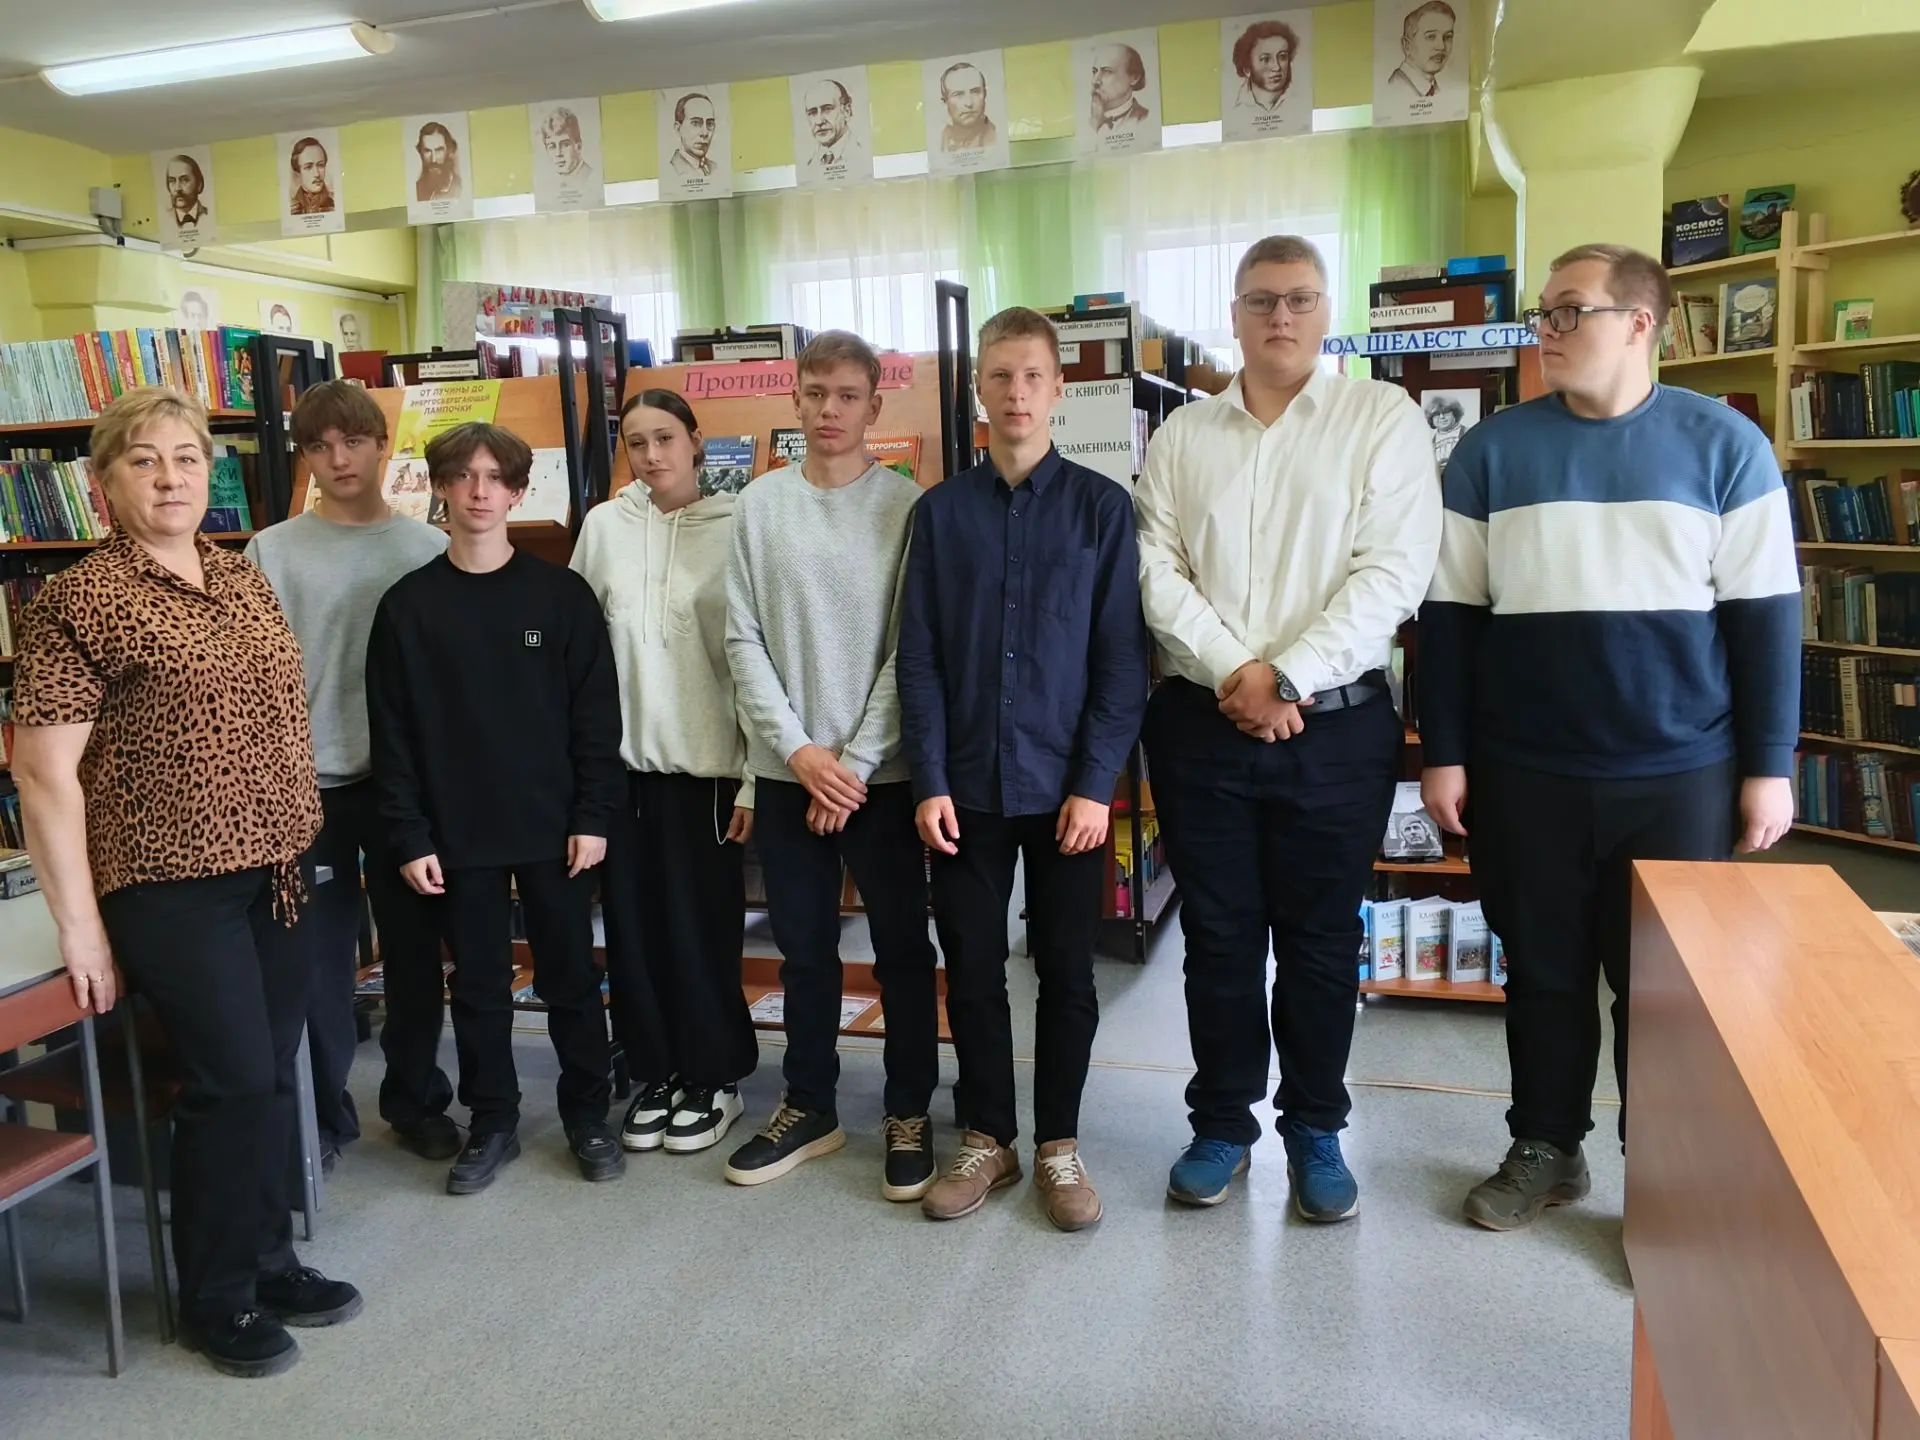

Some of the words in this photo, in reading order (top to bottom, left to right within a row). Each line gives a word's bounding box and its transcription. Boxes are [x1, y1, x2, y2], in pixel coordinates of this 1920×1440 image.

[1675, 218, 1724, 232] КОСМОС
[482, 286, 586, 317] КАМЧАТКА
[1370, 305, 1437, 319] ФАНТАСТИКА
[1366, 330, 1467, 353] ШЕЛЕСТ
[1075, 383, 1120, 398] КНИГОЙ
[423, 404, 472, 415] ЛАМПОЧКИ
[1056, 441, 1131, 455] ЕЗАМЕНИМАЯ
